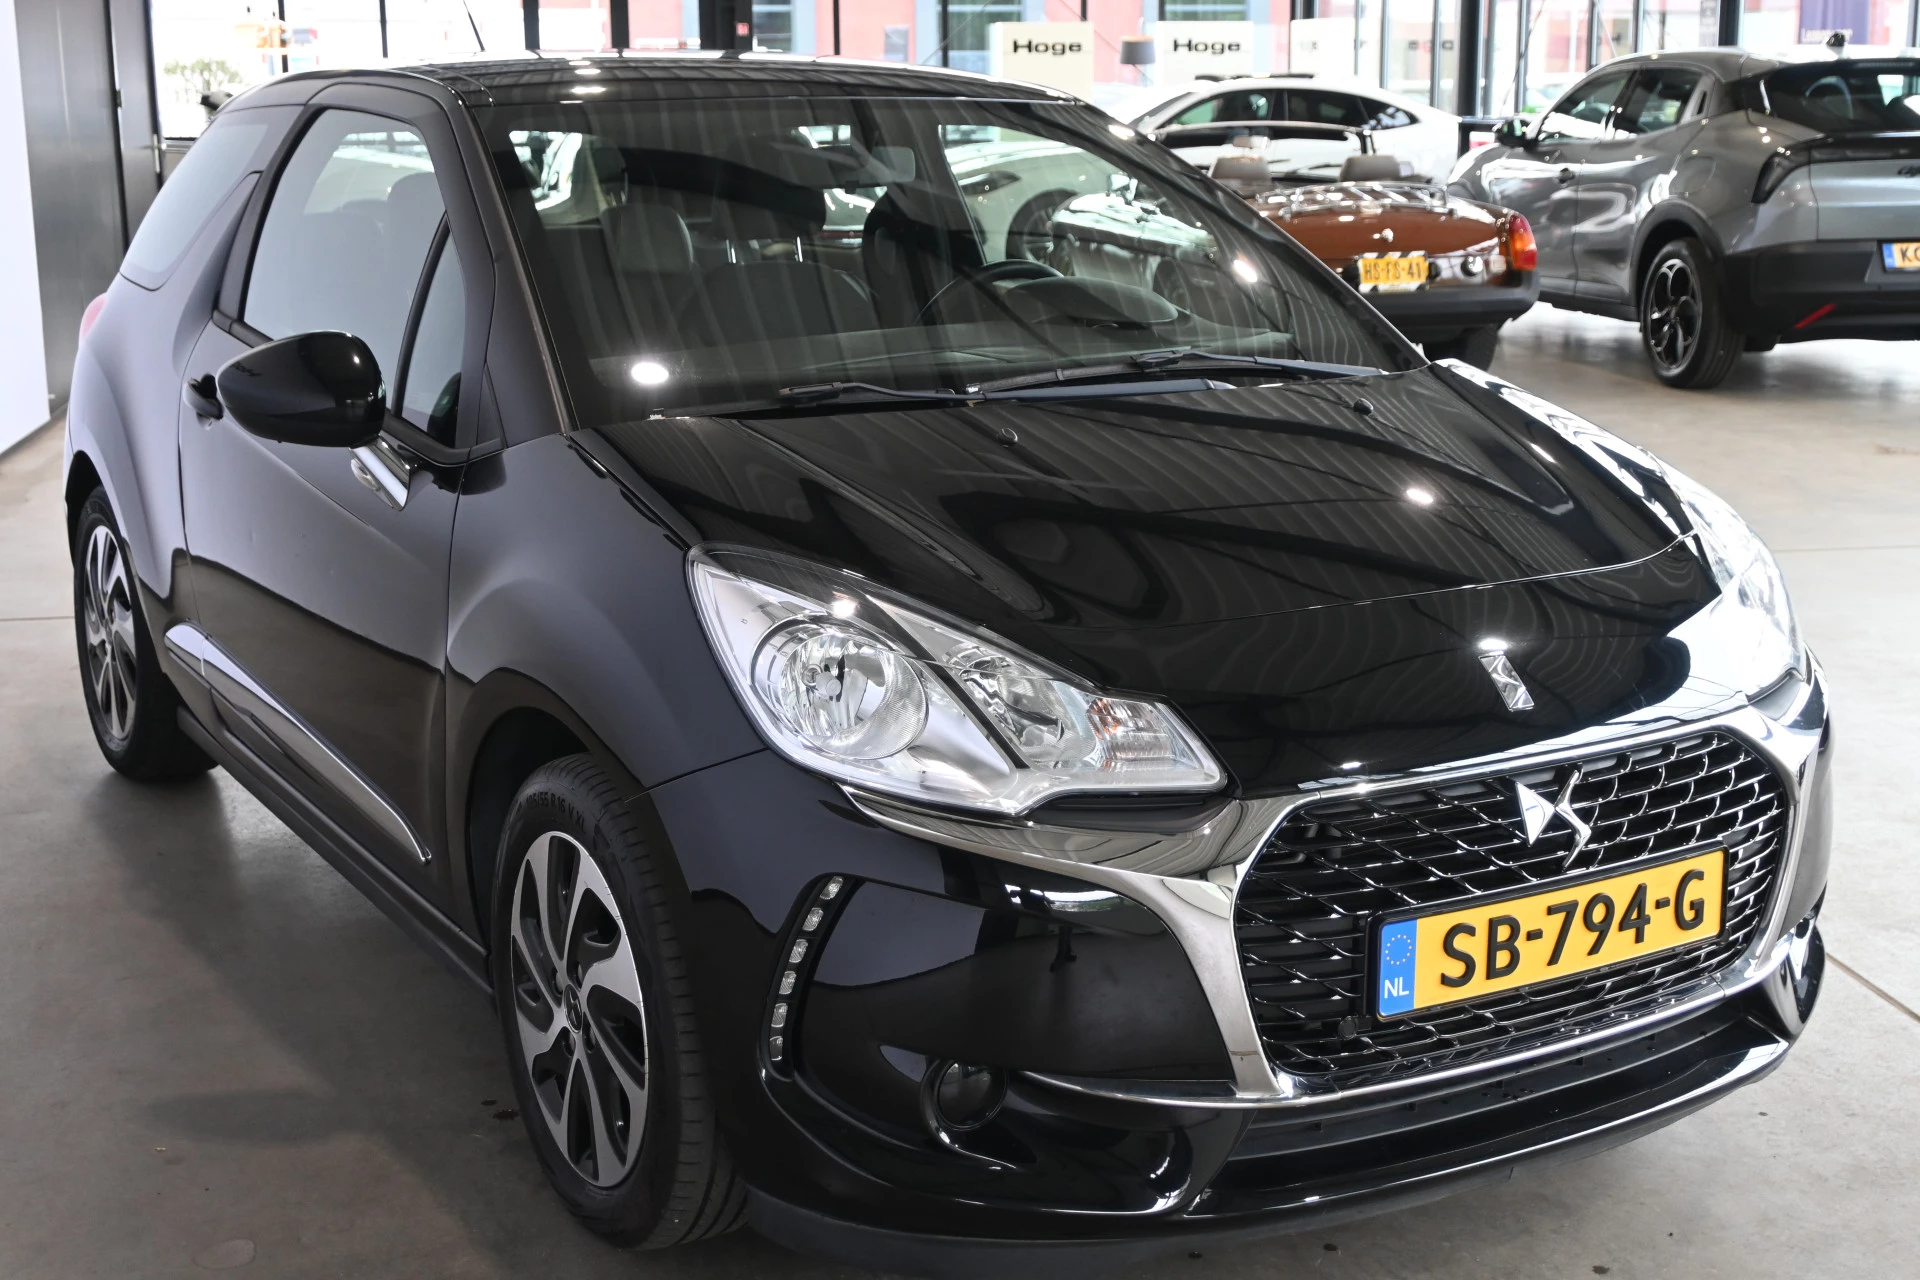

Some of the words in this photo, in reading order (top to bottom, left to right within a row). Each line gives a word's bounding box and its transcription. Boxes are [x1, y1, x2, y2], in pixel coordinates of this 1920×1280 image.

[1013, 39, 1082, 55] Hoge
[1173, 38, 1241, 54] Hoge
[1363, 261, 1422, 281] HS-FS-41
[1440, 868, 1705, 988] SB-794-G
[1383, 976, 1410, 999] NL
